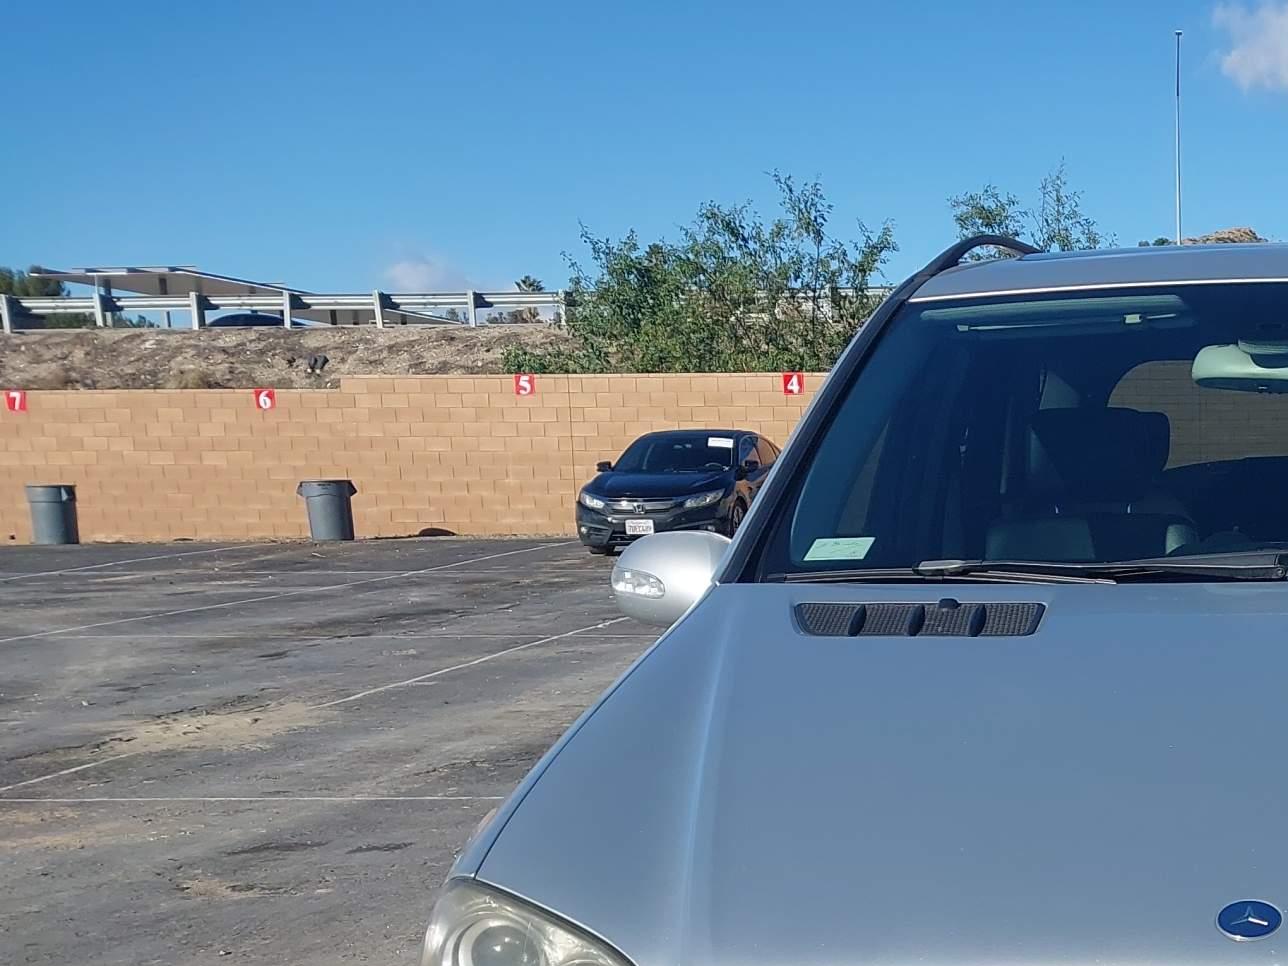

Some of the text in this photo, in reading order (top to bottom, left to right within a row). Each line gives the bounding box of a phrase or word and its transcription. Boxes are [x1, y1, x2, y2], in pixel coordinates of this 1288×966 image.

[518, 375, 531, 395] 5
[787, 374, 800, 394] 4
[9, 391, 21, 410] 7
[258, 390, 272, 409] 6
